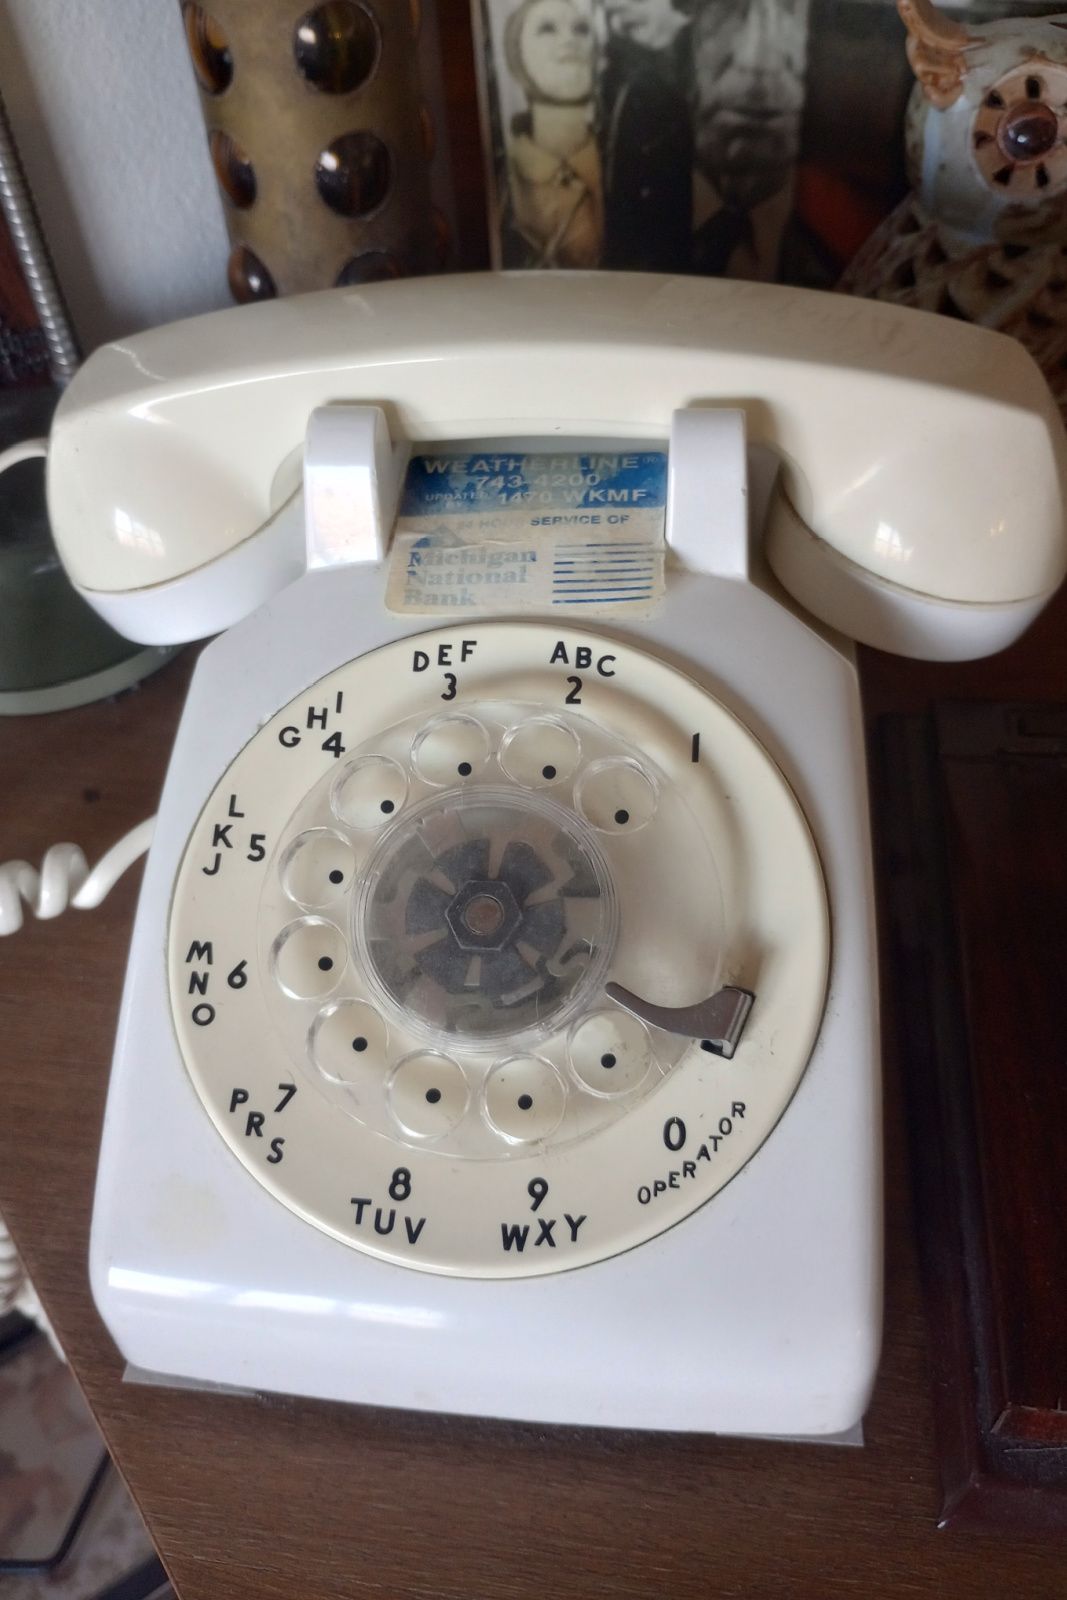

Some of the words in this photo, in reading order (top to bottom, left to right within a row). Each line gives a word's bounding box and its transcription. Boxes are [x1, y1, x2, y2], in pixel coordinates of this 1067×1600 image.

[425, 456, 640, 474] WEATHERLINE
[475, 474, 601, 489] 743-4200
[499, 491, 553, 505] 1470
[563, 489, 648, 503] WKMF
[530, 515, 601, 527] SERVICE
[607, 515, 630, 525] OF
[407, 548, 538, 568] Michigan
[405, 566, 528, 586] National
[402, 588, 477, 606] Bank
[412, 640, 477, 672] DEF
[550, 641, 616, 677] ABC
[441, 673, 457, 701] 3
[565, 676, 583, 704] 2
[322, 732, 346, 758] 4
[691, 732, 700, 762] 1
[247, 834, 266, 861] 5
[227, 959, 248, 989] 6
[274, 1083, 297, 1112] 7
[663, 1116, 686, 1151] 0
[637, 1101, 746, 1204] OPERATOR
[388, 1166, 411, 1201] 8
[527, 1177, 549, 1211] 9
[351, 1197, 426, 1244] TUV
[501, 1214, 587, 1252] WXY
